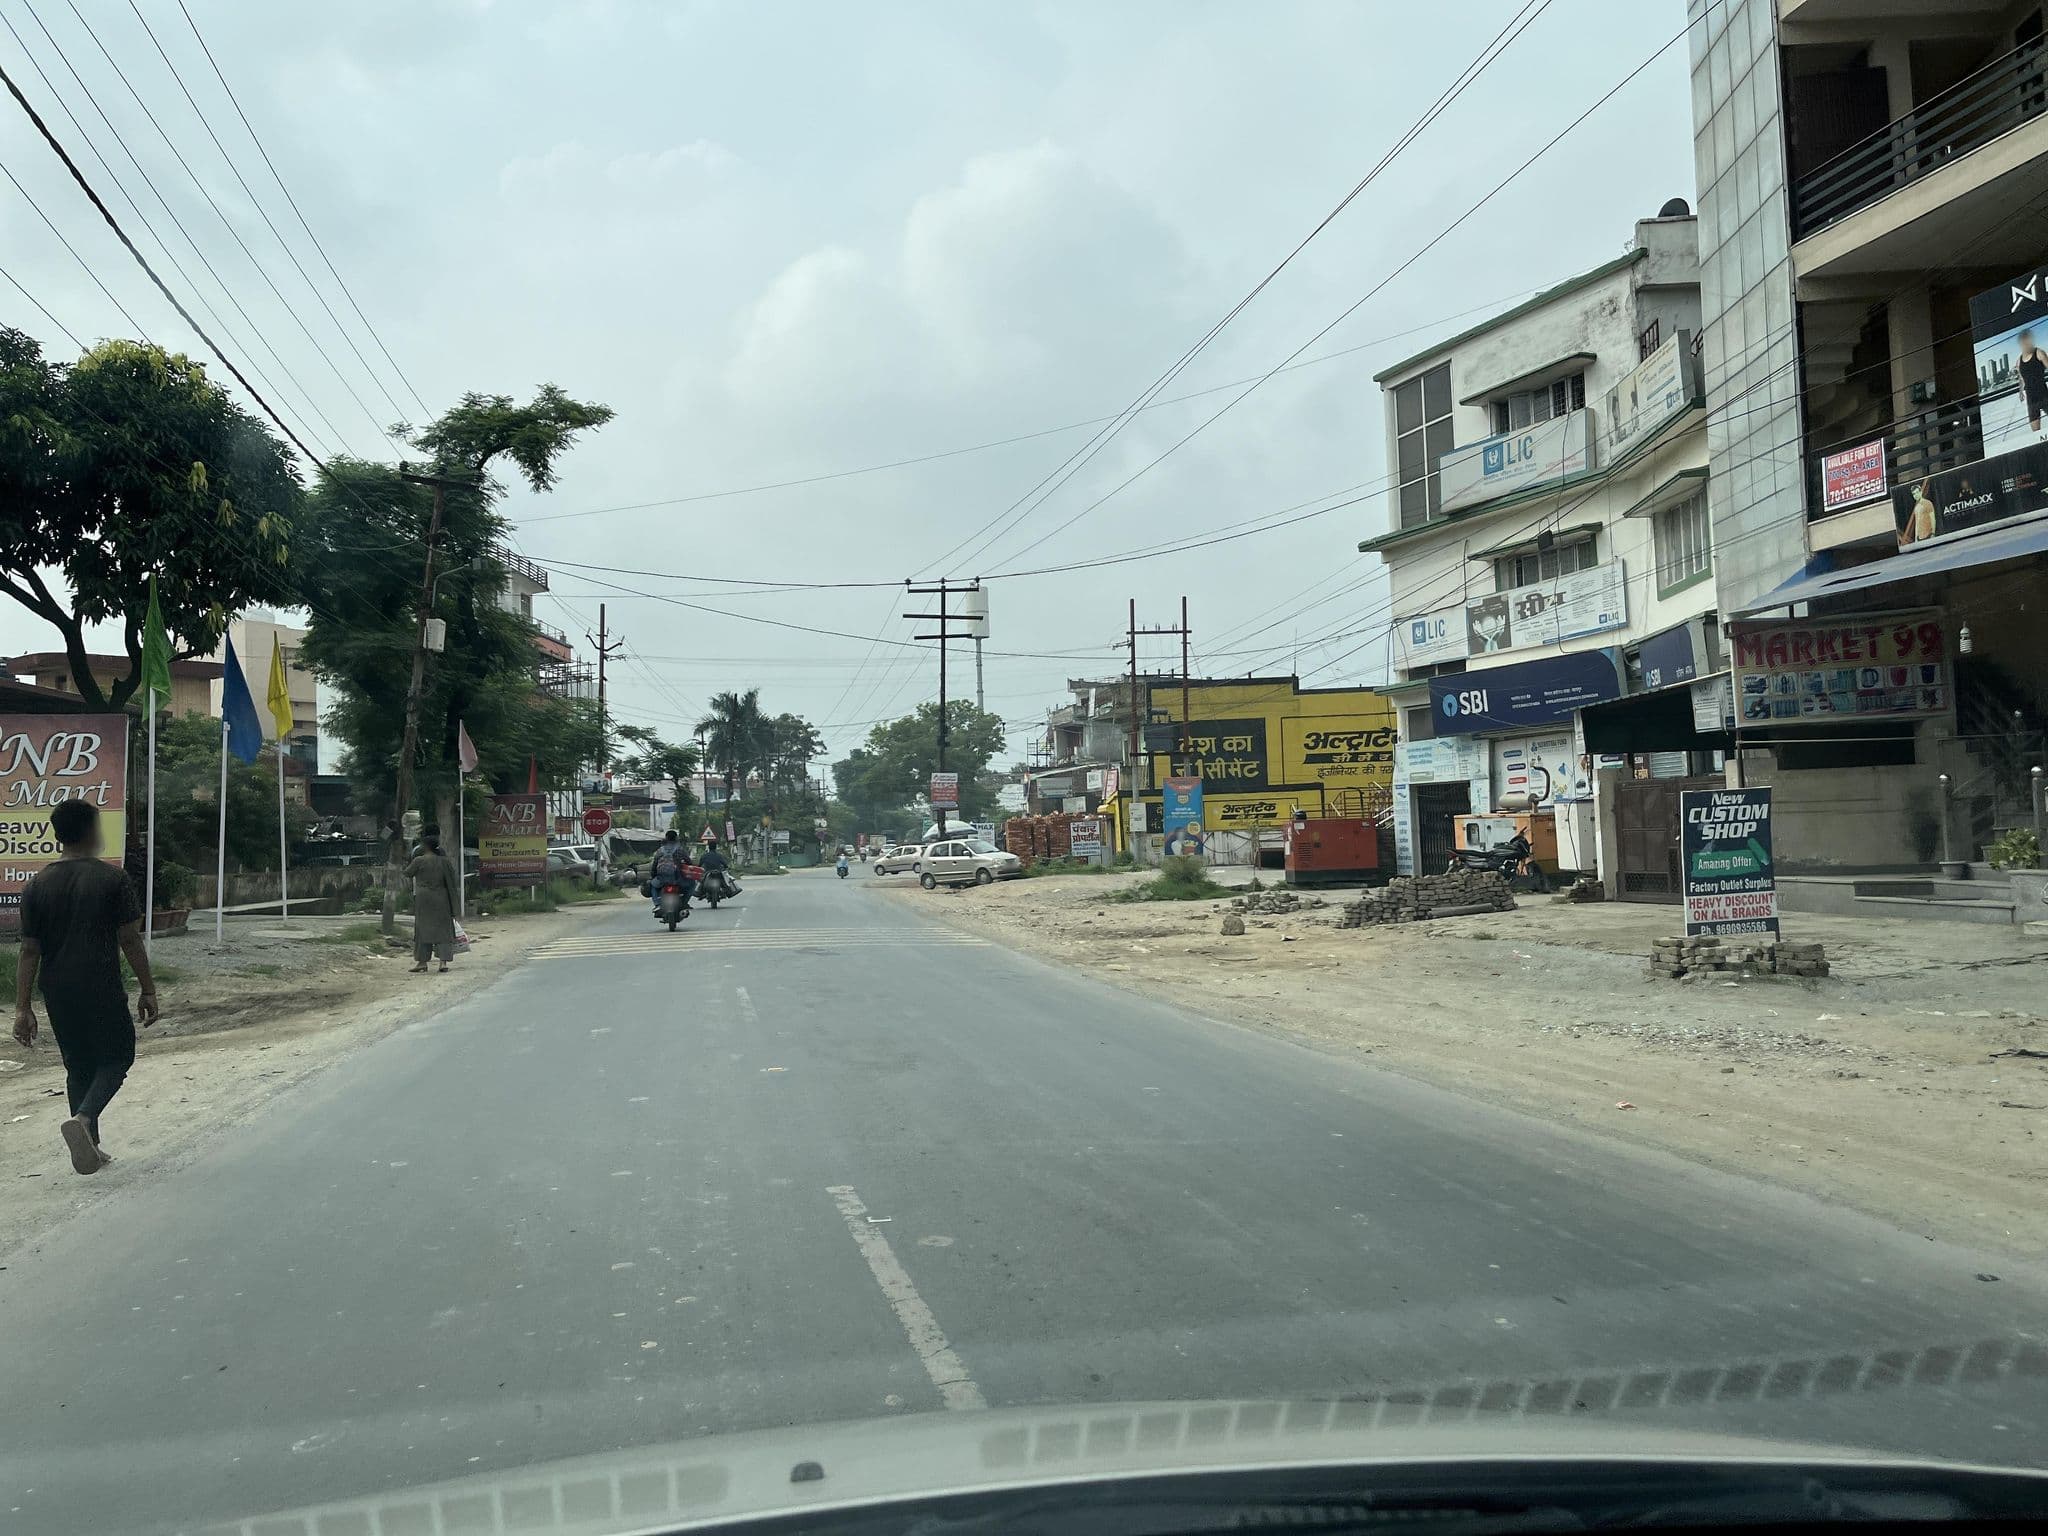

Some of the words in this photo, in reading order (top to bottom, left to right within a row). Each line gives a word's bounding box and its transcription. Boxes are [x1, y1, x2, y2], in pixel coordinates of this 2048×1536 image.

[1507, 435, 1533, 465] LIC
[1943, 492, 1993, 515] ACTIMAXX
[1427, 619, 1446, 639] LIC
[1735, 628, 1883, 669] MARKET
[1892, 623, 1945, 659] 99
[1651, 667, 1661, 686] SBI
[1459, 689, 1489, 715] SBI
[1222, 735, 1253, 753] का
[5, 779, 112, 808] Mart
[1711, 792, 1745, 806] New
[490, 803, 536, 823] NB
[1688, 804, 1769, 823] CUSTOM
[0, 821, 50, 839] eavy
[496, 824, 540, 836] Mart
[1701, 821, 1757, 840] SHOP
[0, 837, 64, 854] Discou
[1698, 858, 1730, 870] Amazing
[1732, 855, 1752, 868] Offer
[1690, 881, 1718, 893] Factory
[1720, 878, 1743, 890] Outlet
[1744, 876, 1772, 890] Surplus
[1689, 897, 1722, 909] HEAVY
[1725, 893, 1774, 907] DISCOUNT
[1693, 910, 1708, 921] ON
[1711, 908, 1729, 920] ALL
[1732, 905, 1772, 917] BRANDS
[1701, 925, 1714, 936] Ph.
